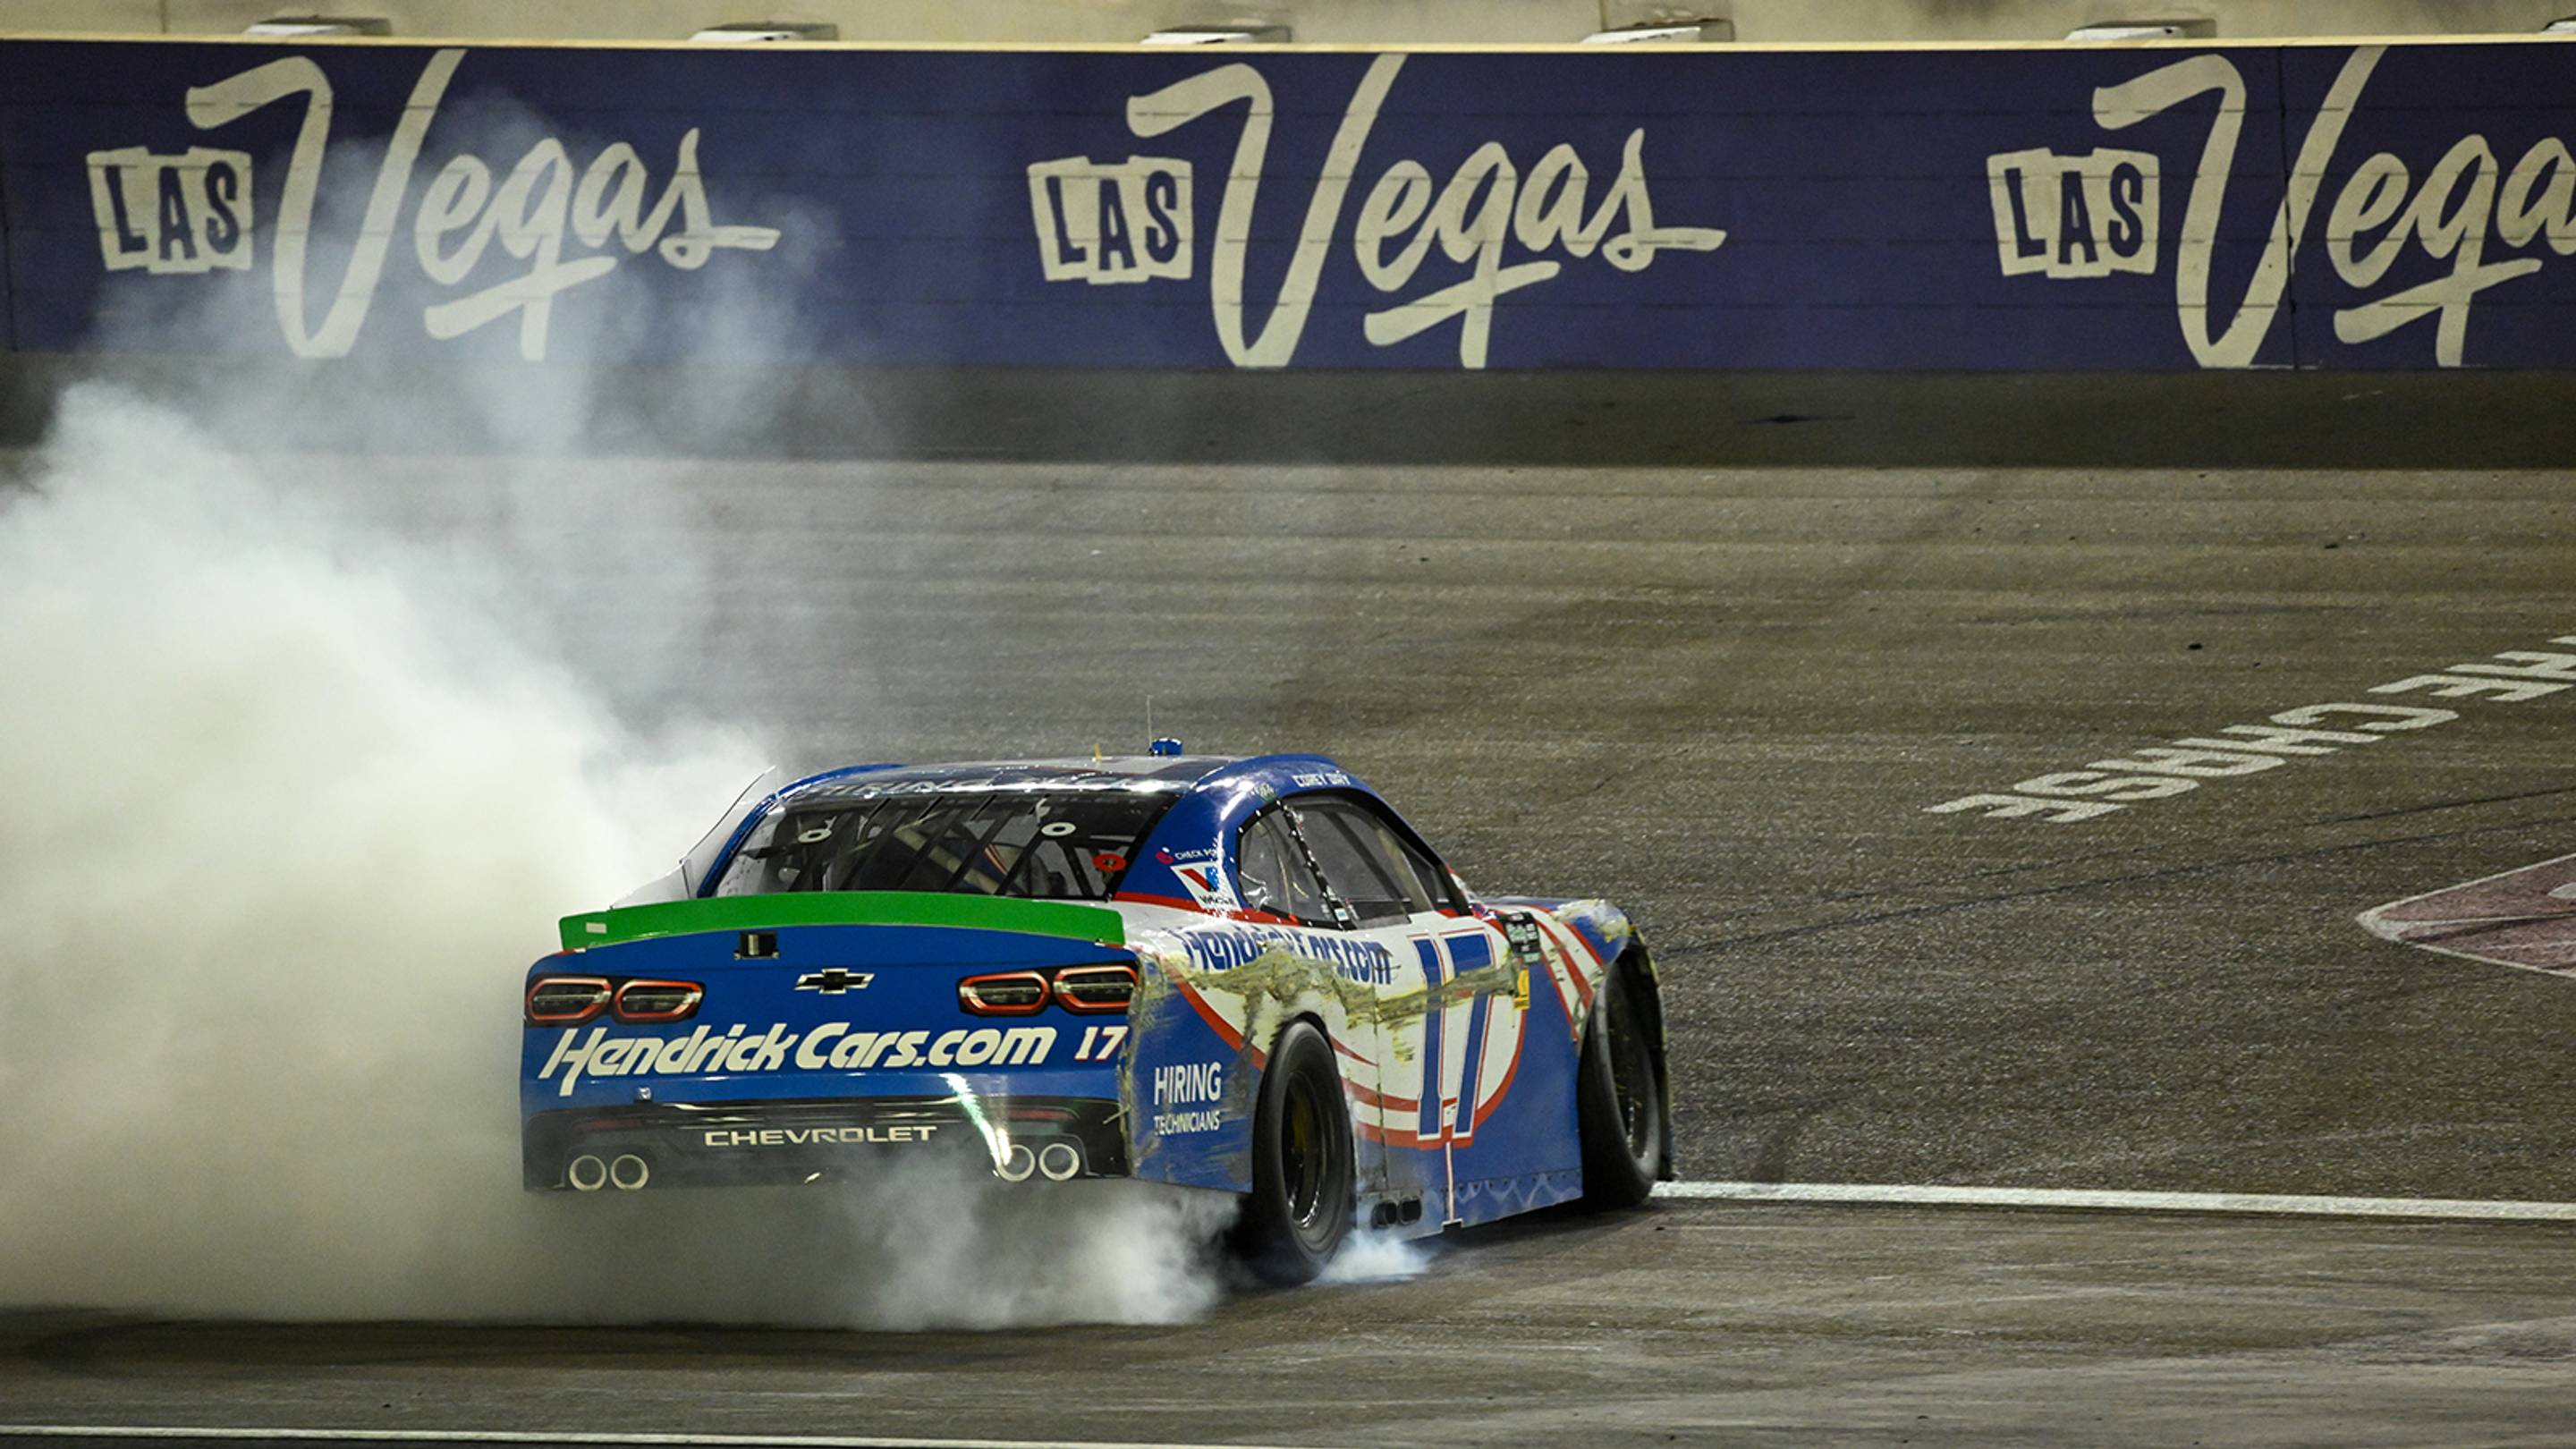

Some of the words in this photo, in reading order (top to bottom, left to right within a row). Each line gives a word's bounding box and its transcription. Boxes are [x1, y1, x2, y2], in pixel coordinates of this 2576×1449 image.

[105, 159, 241, 262] LAS
[186, 48, 780, 360] Vegas
[1046, 168, 1180, 273] LAS
[1126, 53, 1727, 368] Vegas
[2002, 160, 2146, 267] LAS
[2092, 46, 2576, 368] Vega
[2368, 635, 2576, 702] HE
[1923, 702, 2460, 823] CHASE
[1074, 1025, 1130, 1062] 17
[1154, 1062, 1222, 1106] HIRING
[704, 1125, 937, 1147] CHEVROLET
[1153, 1110, 1220, 1136] TECHNICIANS
